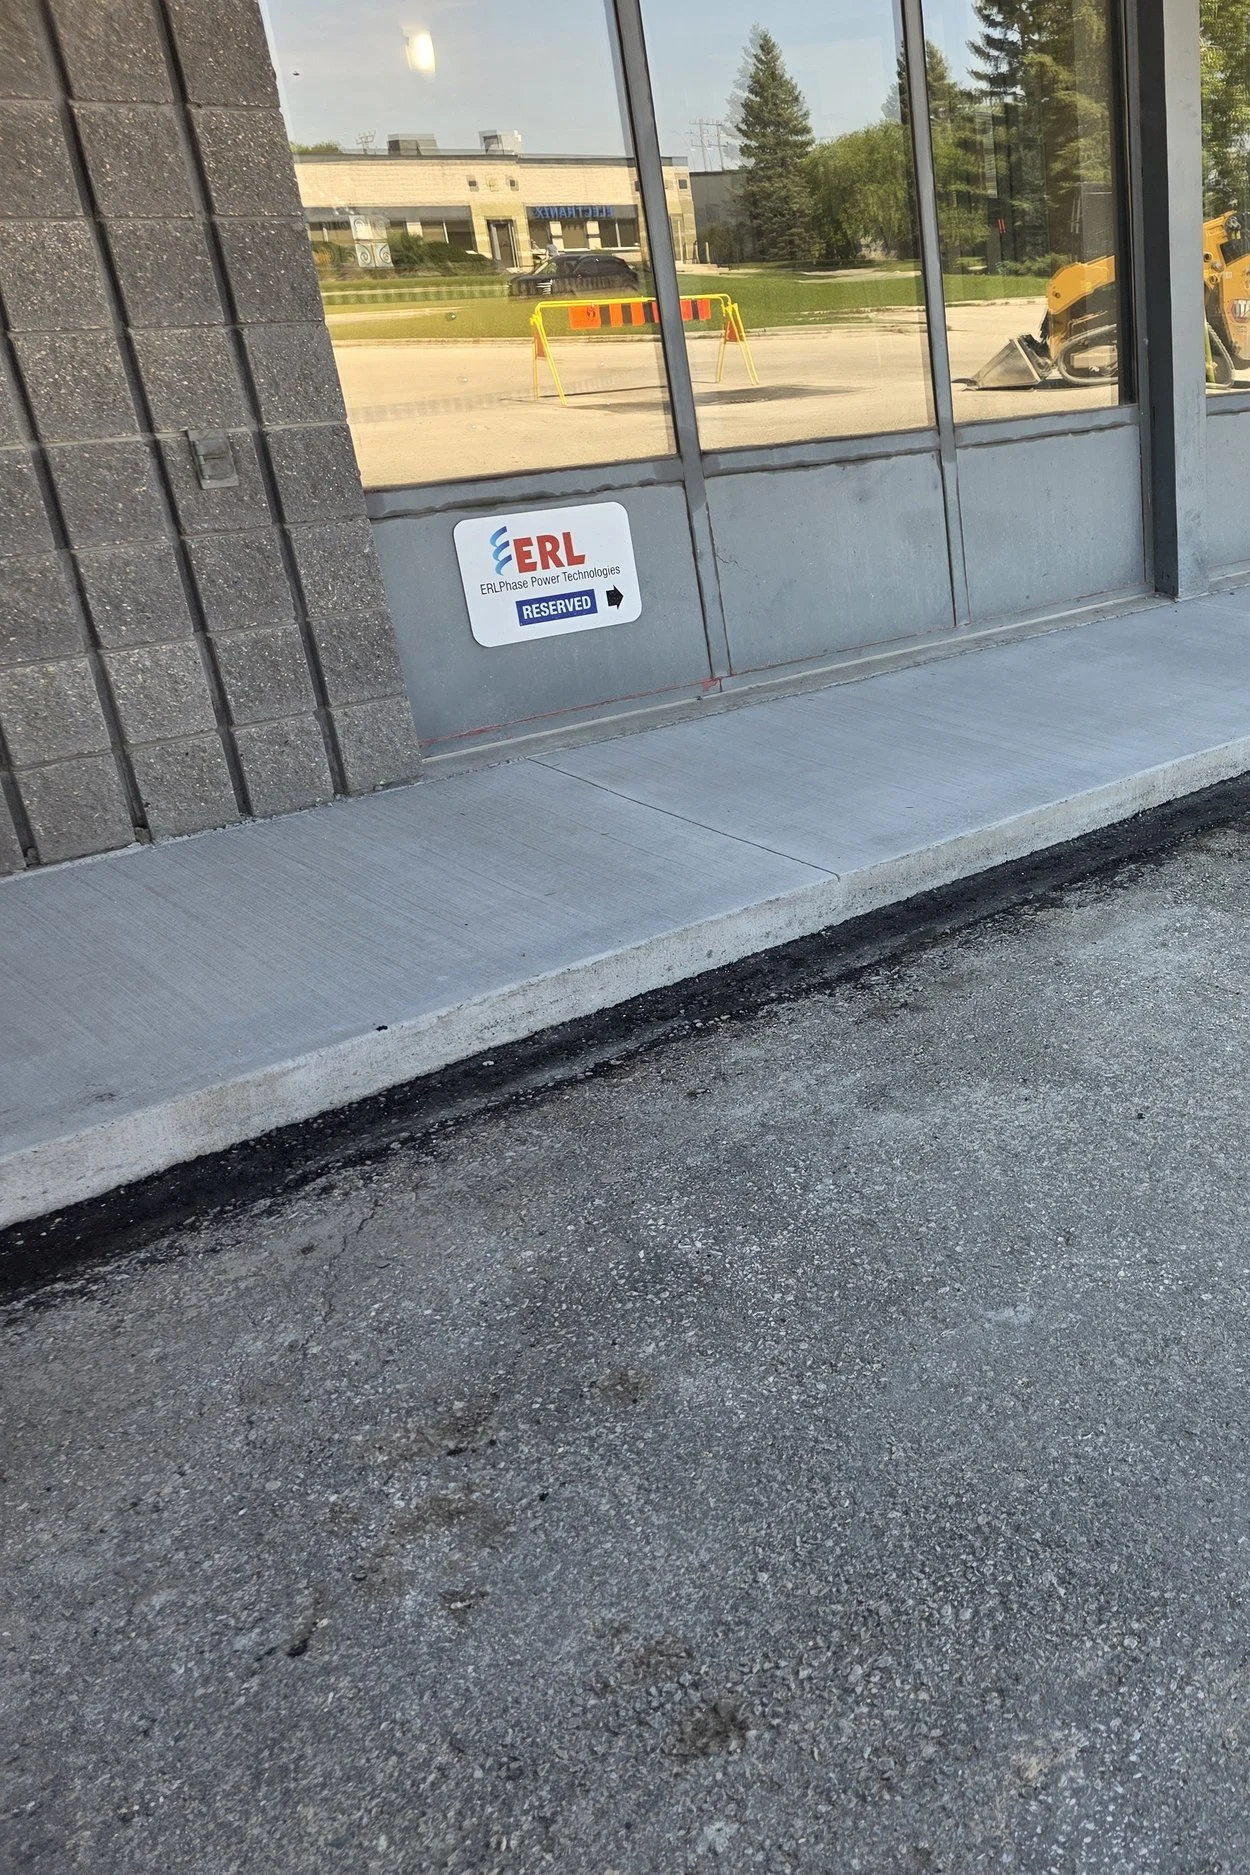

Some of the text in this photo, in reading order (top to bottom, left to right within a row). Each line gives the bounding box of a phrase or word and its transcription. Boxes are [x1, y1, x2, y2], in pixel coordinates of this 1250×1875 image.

[513, 531, 586, 574] ERL
[480, 565, 621, 595] ERLPhase Power Technologies
[522, 595, 592, 620] RESERVED
